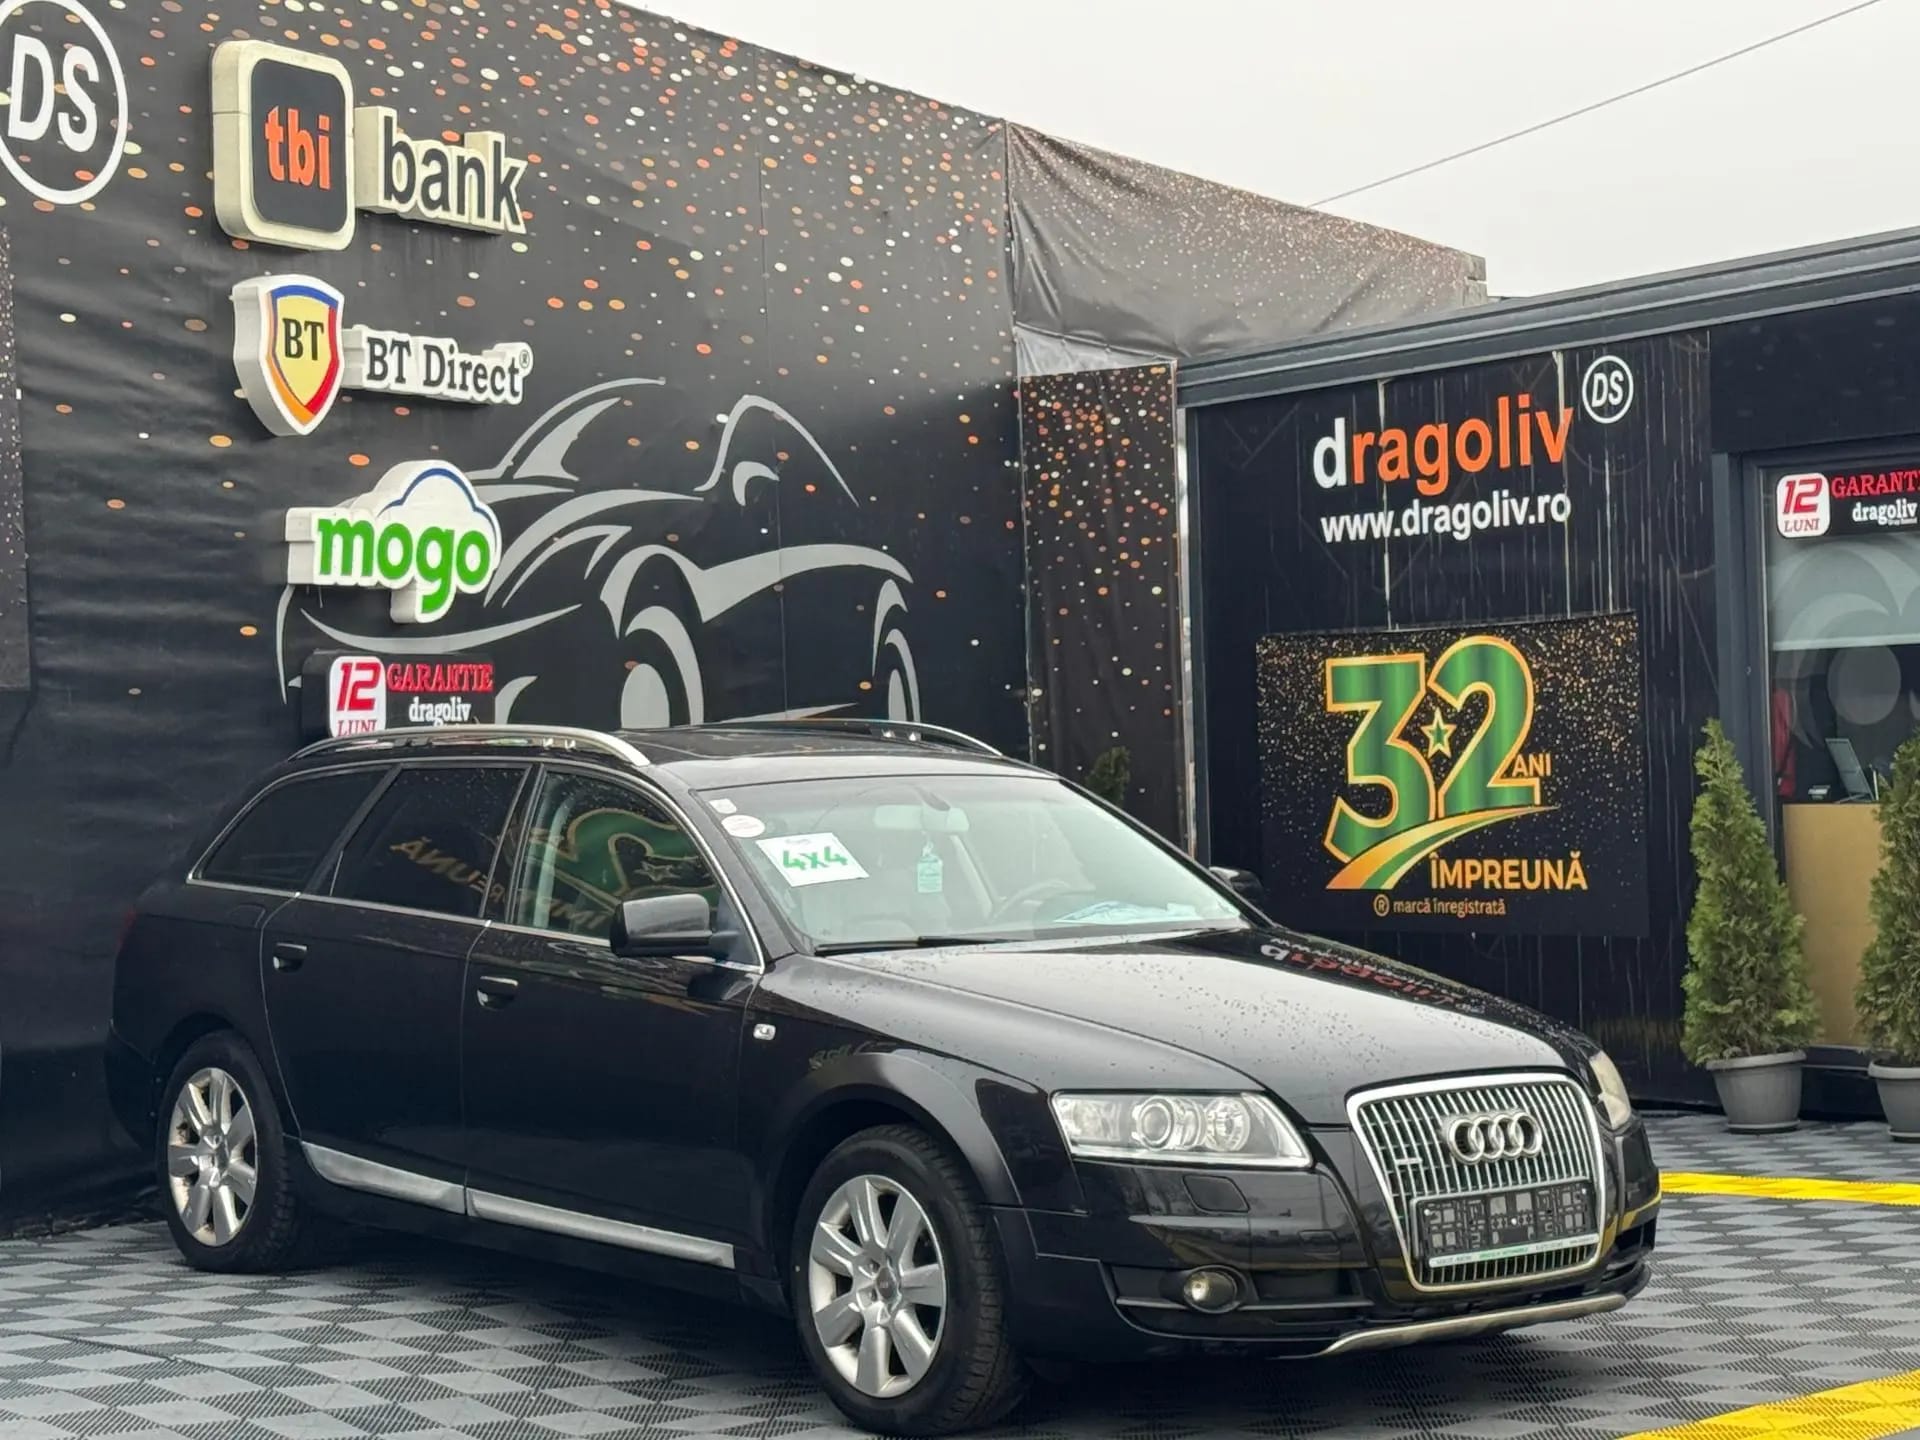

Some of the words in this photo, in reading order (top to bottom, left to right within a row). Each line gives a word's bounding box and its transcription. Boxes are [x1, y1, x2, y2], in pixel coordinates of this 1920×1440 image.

[8, 33, 99, 152] DS
[264, 105, 331, 190] tbi
[382, 115, 528, 234] bank
[282, 317, 325, 361] BT
[366, 336, 411, 384] BT
[1591, 372, 1623, 408] DS
[1312, 393, 1574, 496] dragoliv
[1782, 478, 1823, 515] 12
[1831, 470, 1920, 499] GARANT
[1320, 489, 1572, 543] www.dragoliv.ro
[1784, 518, 1820, 532] LUNI
[1852, 498, 1918, 526] dragoliv
[317, 518, 490, 614] mogo
[336, 662, 381, 711] 12
[387, 663, 494, 692] GARANTIE
[408, 696, 471, 727] dragoliv
[1324, 635, 1540, 864] 32
[1512, 752, 1552, 777] ANI
[1430, 851, 1588, 890] ÎMPREUNĂ
